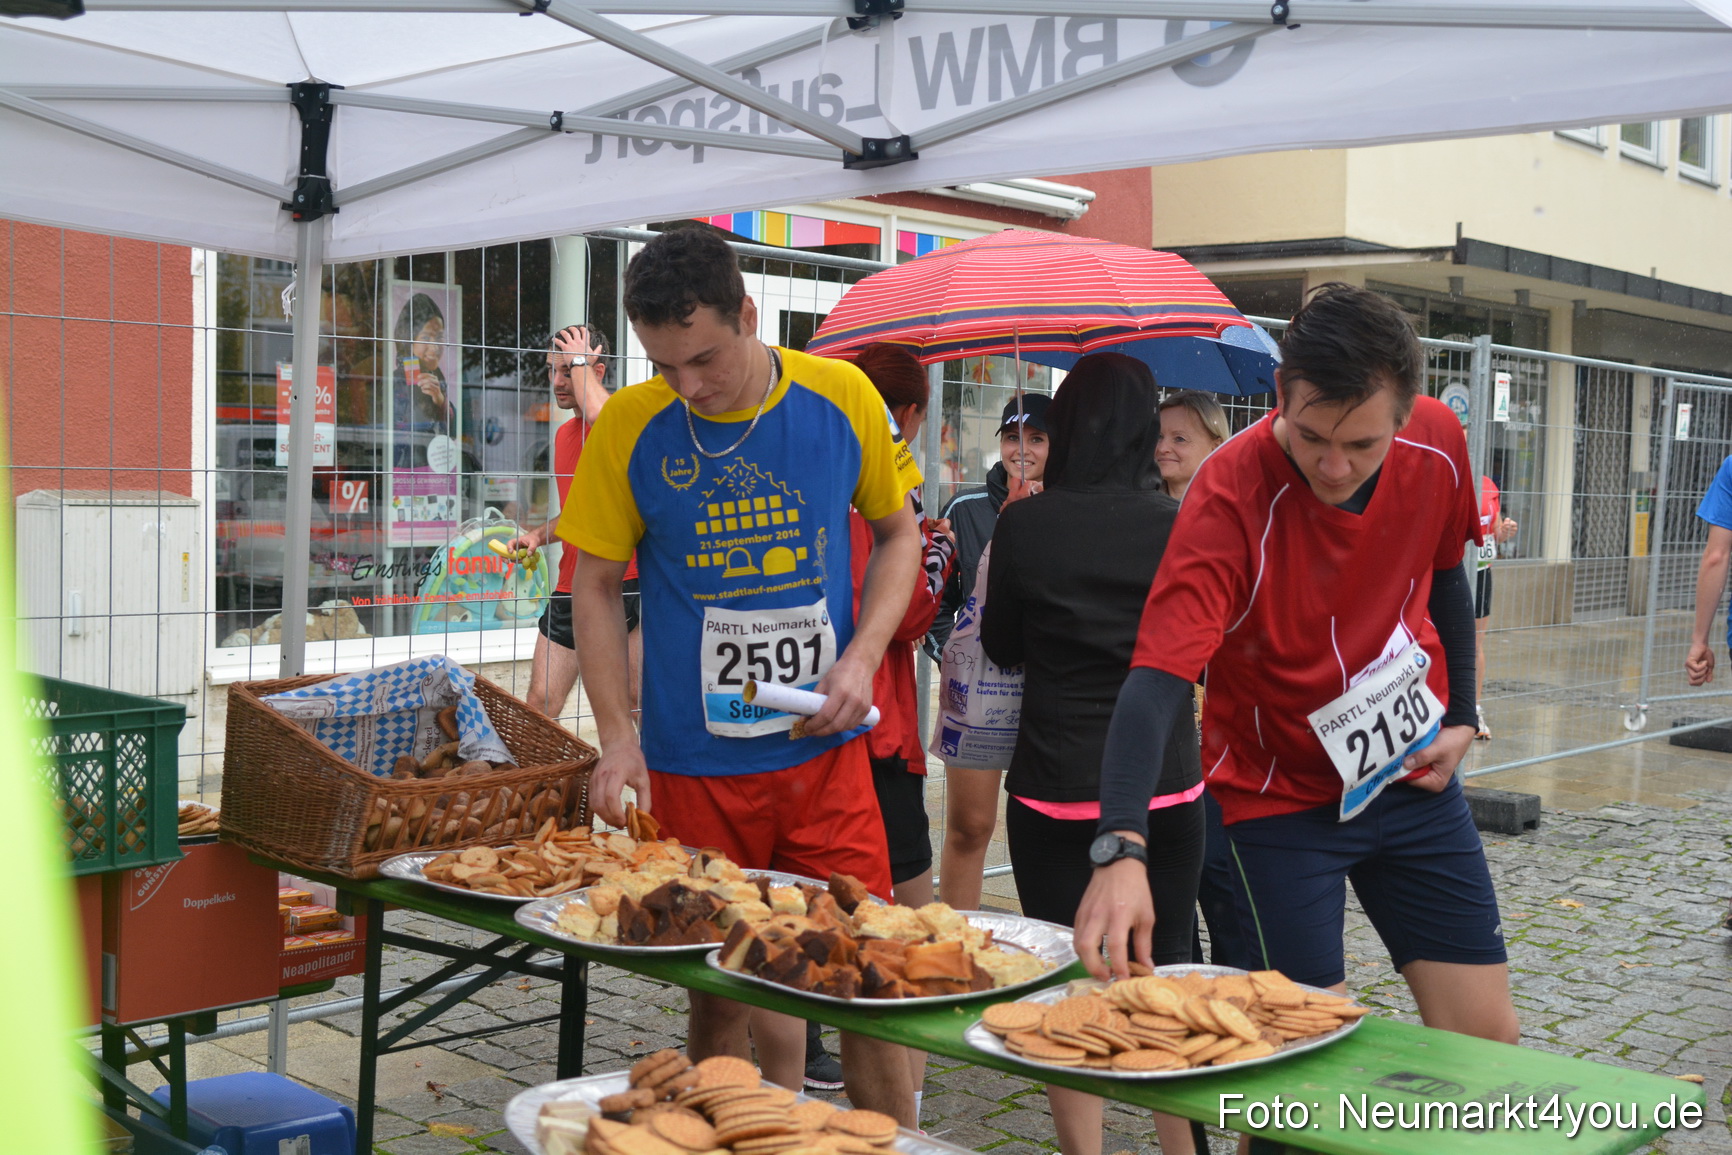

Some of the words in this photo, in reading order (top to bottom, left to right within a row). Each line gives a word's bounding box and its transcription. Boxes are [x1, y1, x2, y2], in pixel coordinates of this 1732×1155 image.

[675, 458, 685, 466] 15
[670, 468, 692, 478] Jahre
[700, 535, 773, 550] 21.September
[776, 528, 801, 542] 2014
[447, 546, 515, 580] family
[351, 596, 371, 606] Von
[706, 620, 749, 636] PARTL
[751, 618, 817, 634] Neumarkt
[716, 632, 822, 686] 2591
[976, 687, 999, 696] Laufen
[1000, 688, 1009, 697] für
[1319, 706, 1367, 738] PARTL
[1365, 666, 1415, 709] Neumarkt
[1345, 676, 1430, 781] 2136
[183, 892, 236, 909] Doppelkeks
[282, 949, 357, 979] Neapolitaner
